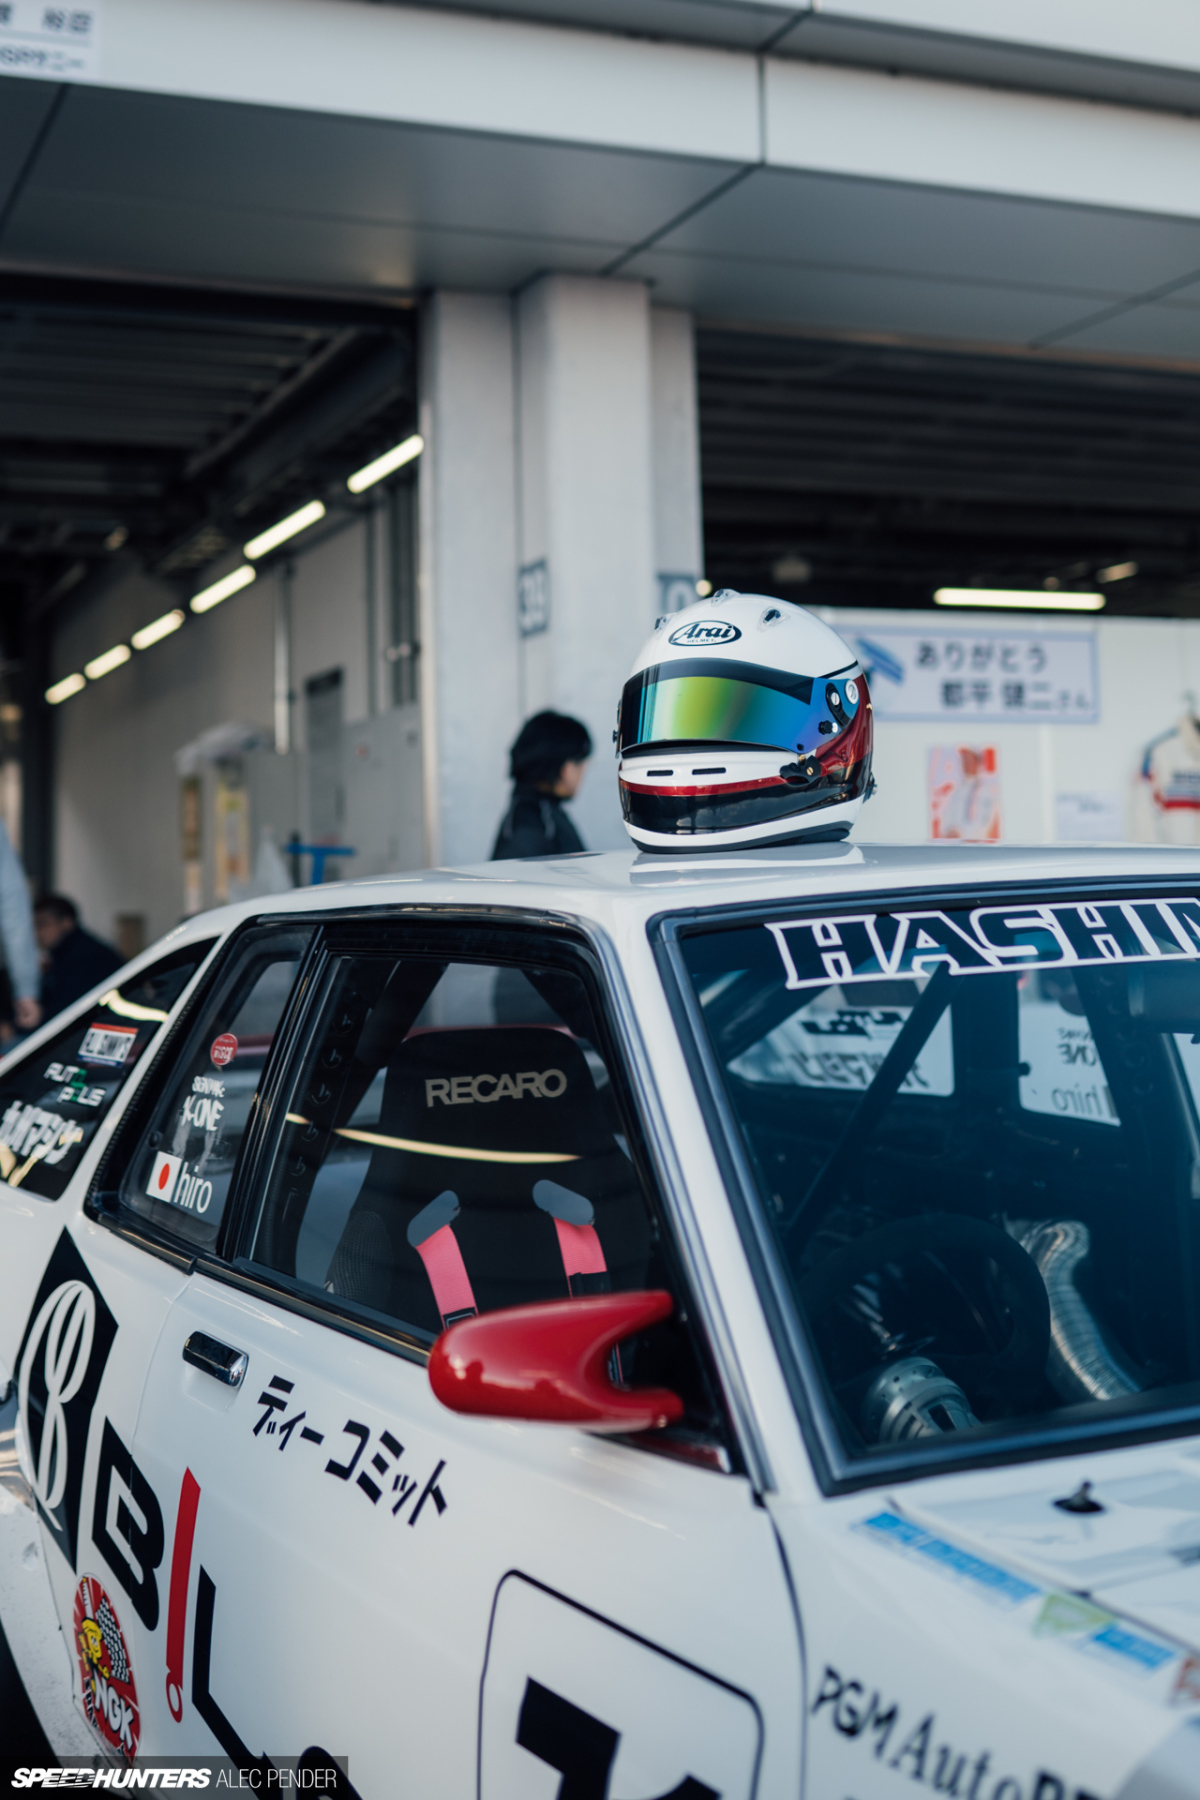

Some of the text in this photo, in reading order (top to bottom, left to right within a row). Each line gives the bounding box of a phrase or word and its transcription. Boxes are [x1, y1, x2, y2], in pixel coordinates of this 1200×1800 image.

[672, 623, 733, 640] Arai
[915, 640, 1047, 673] ありがとう
[425, 1069, 567, 1107] RECARO
[173, 1162, 213, 1214] hiro
[93, 1667, 135, 1753] NGK
[811, 1664, 899, 1760] PGM
